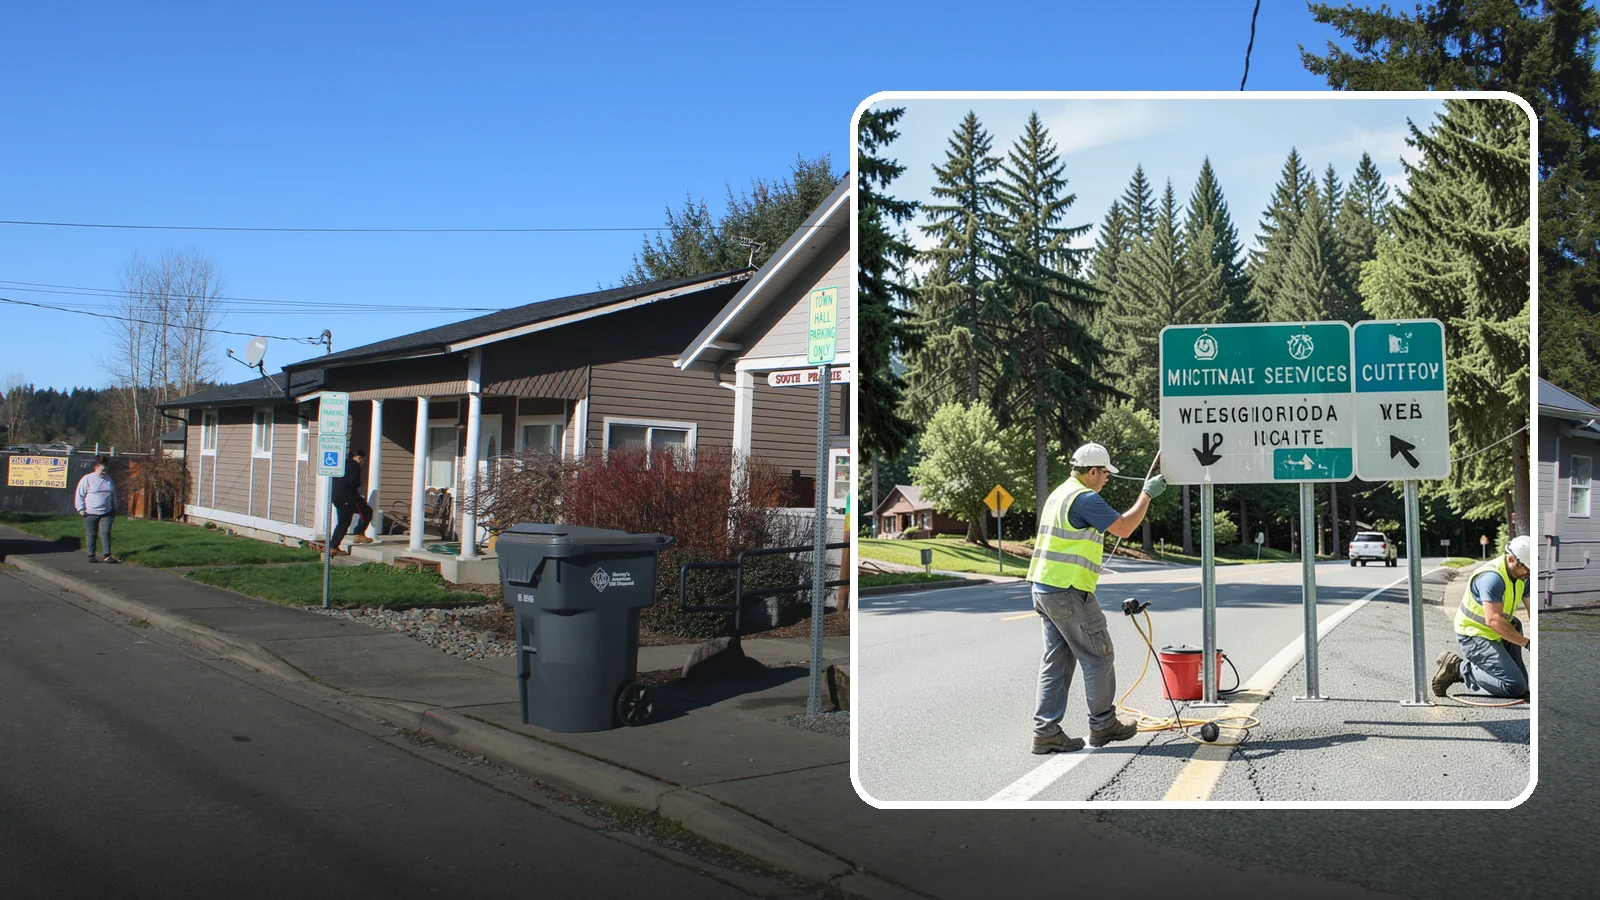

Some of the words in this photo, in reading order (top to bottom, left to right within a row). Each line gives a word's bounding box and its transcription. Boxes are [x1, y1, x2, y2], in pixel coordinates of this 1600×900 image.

[815, 294, 833, 308] TOWN
[814, 312, 831, 324] HALL
[810, 327, 835, 340] PARKING
[813, 344, 831, 357] ONLY
[776, 374, 801, 384] SOUTH
[808, 371, 841, 382] PRIE
